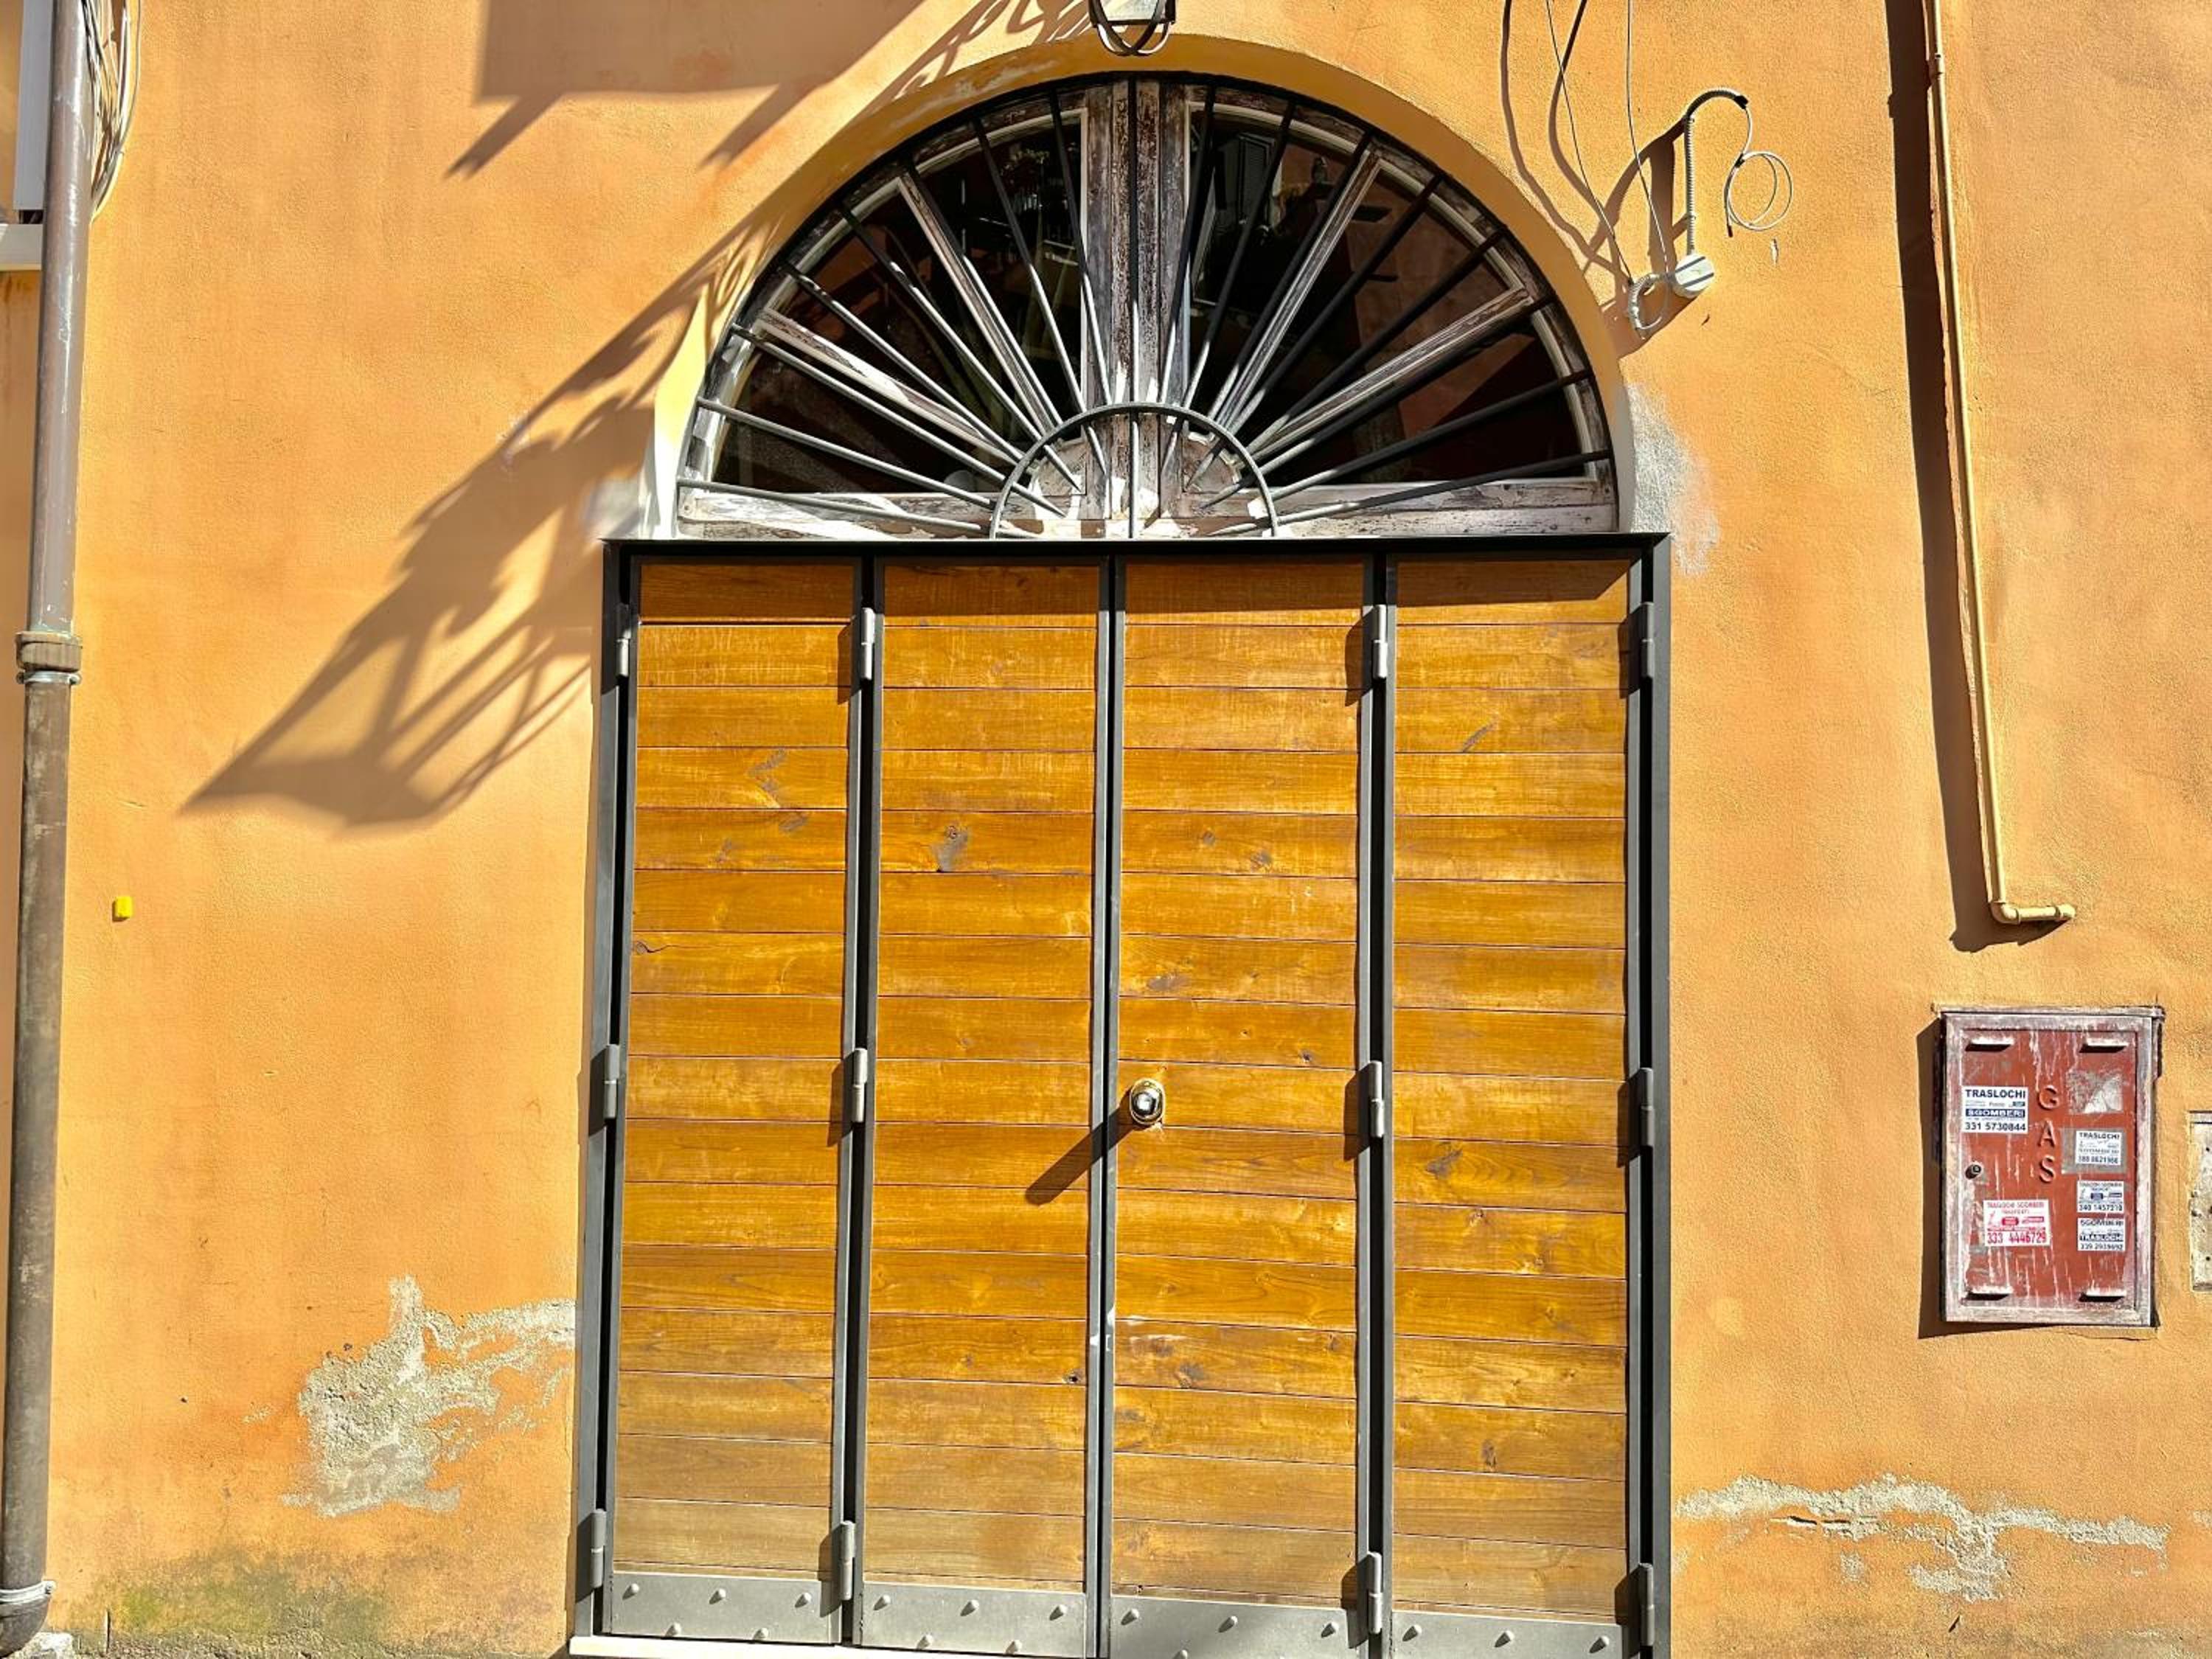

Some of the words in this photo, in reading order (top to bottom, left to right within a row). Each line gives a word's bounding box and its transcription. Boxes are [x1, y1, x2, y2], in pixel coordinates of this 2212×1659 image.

[1965, 1089, 2025, 1099] TRASLOCHI
[1968, 1109, 2025, 1117] SGOMBERI
[1965, 1121, 1981, 1130] 331
[2037, 1085, 2059, 1183] GAS
[2079, 1132, 2120, 1140] TRASLOCHI
[1987, 1232, 2003, 1244] 333
